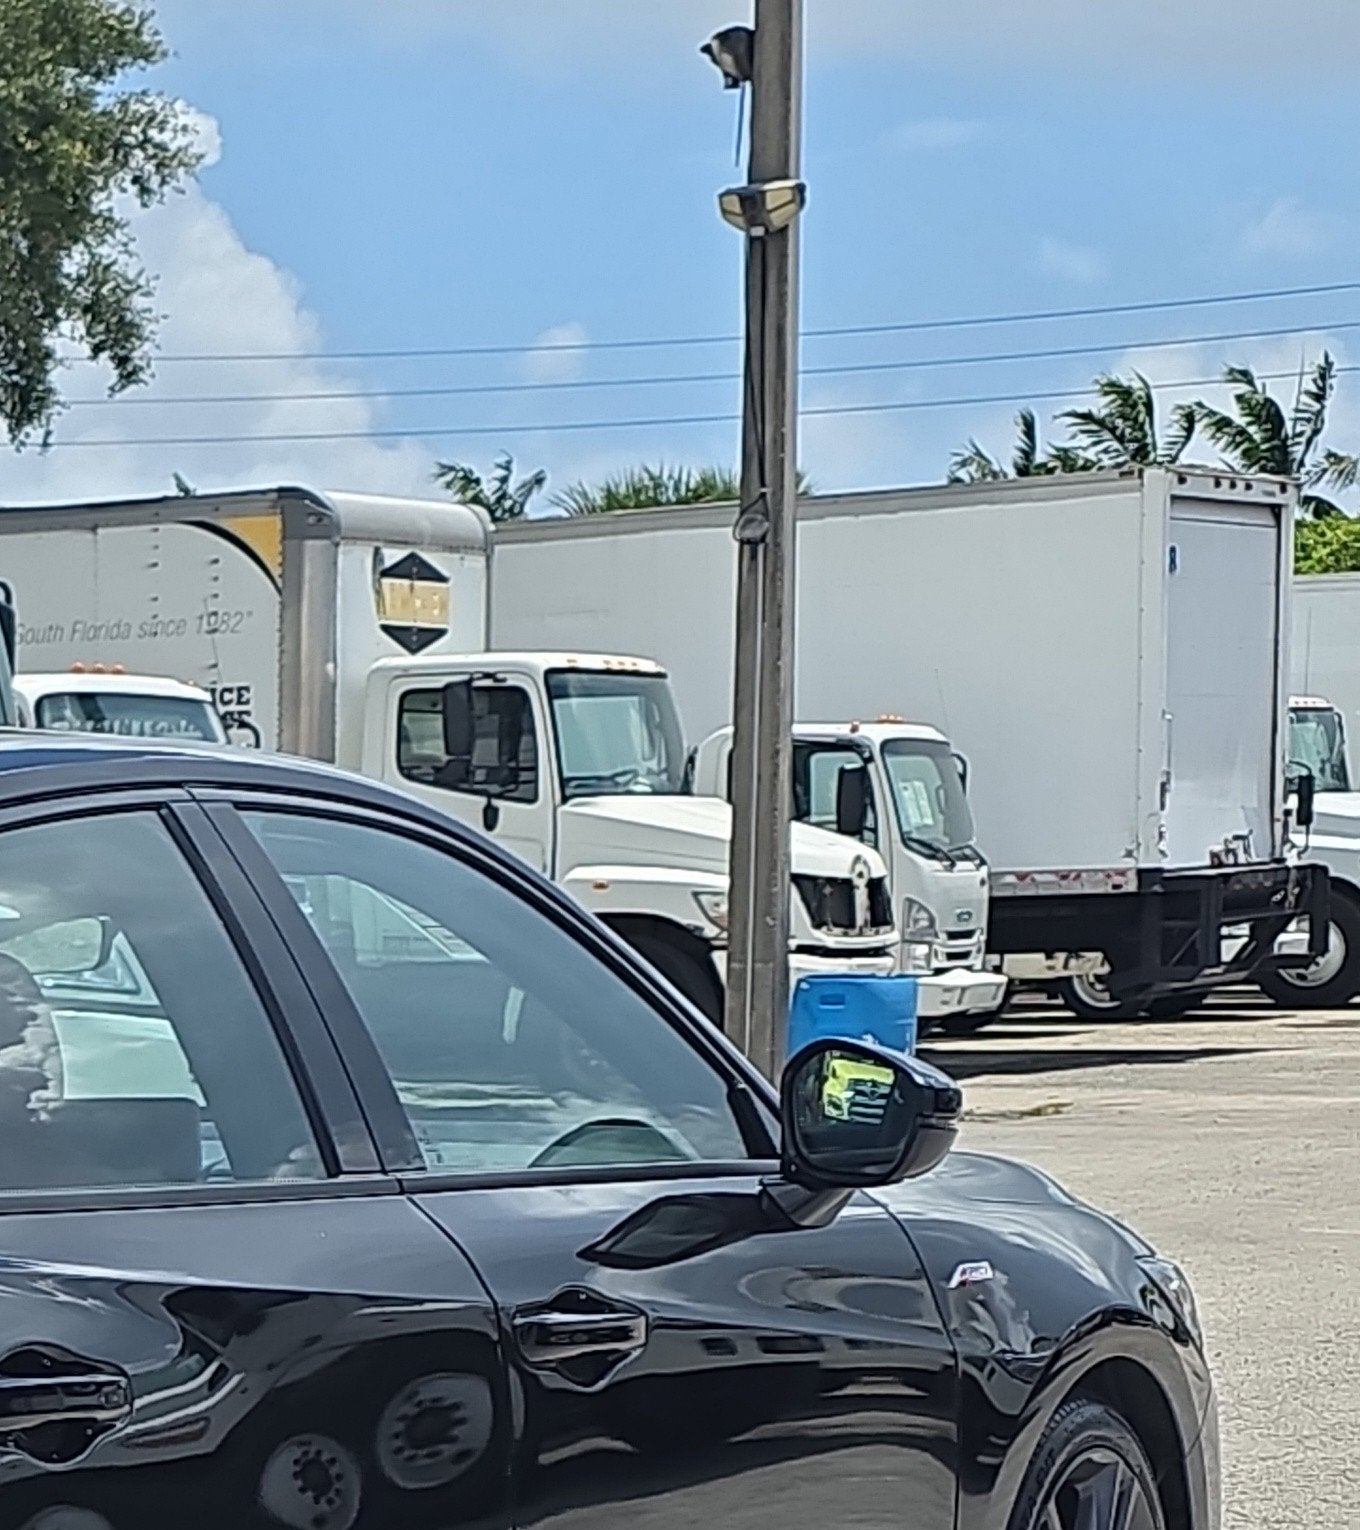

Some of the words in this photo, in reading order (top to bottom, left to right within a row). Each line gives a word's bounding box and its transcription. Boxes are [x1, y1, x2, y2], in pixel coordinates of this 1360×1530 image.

[18, 622, 66, 646] South
[70, 618, 133, 643] Florida
[137, 618, 187, 639] since
